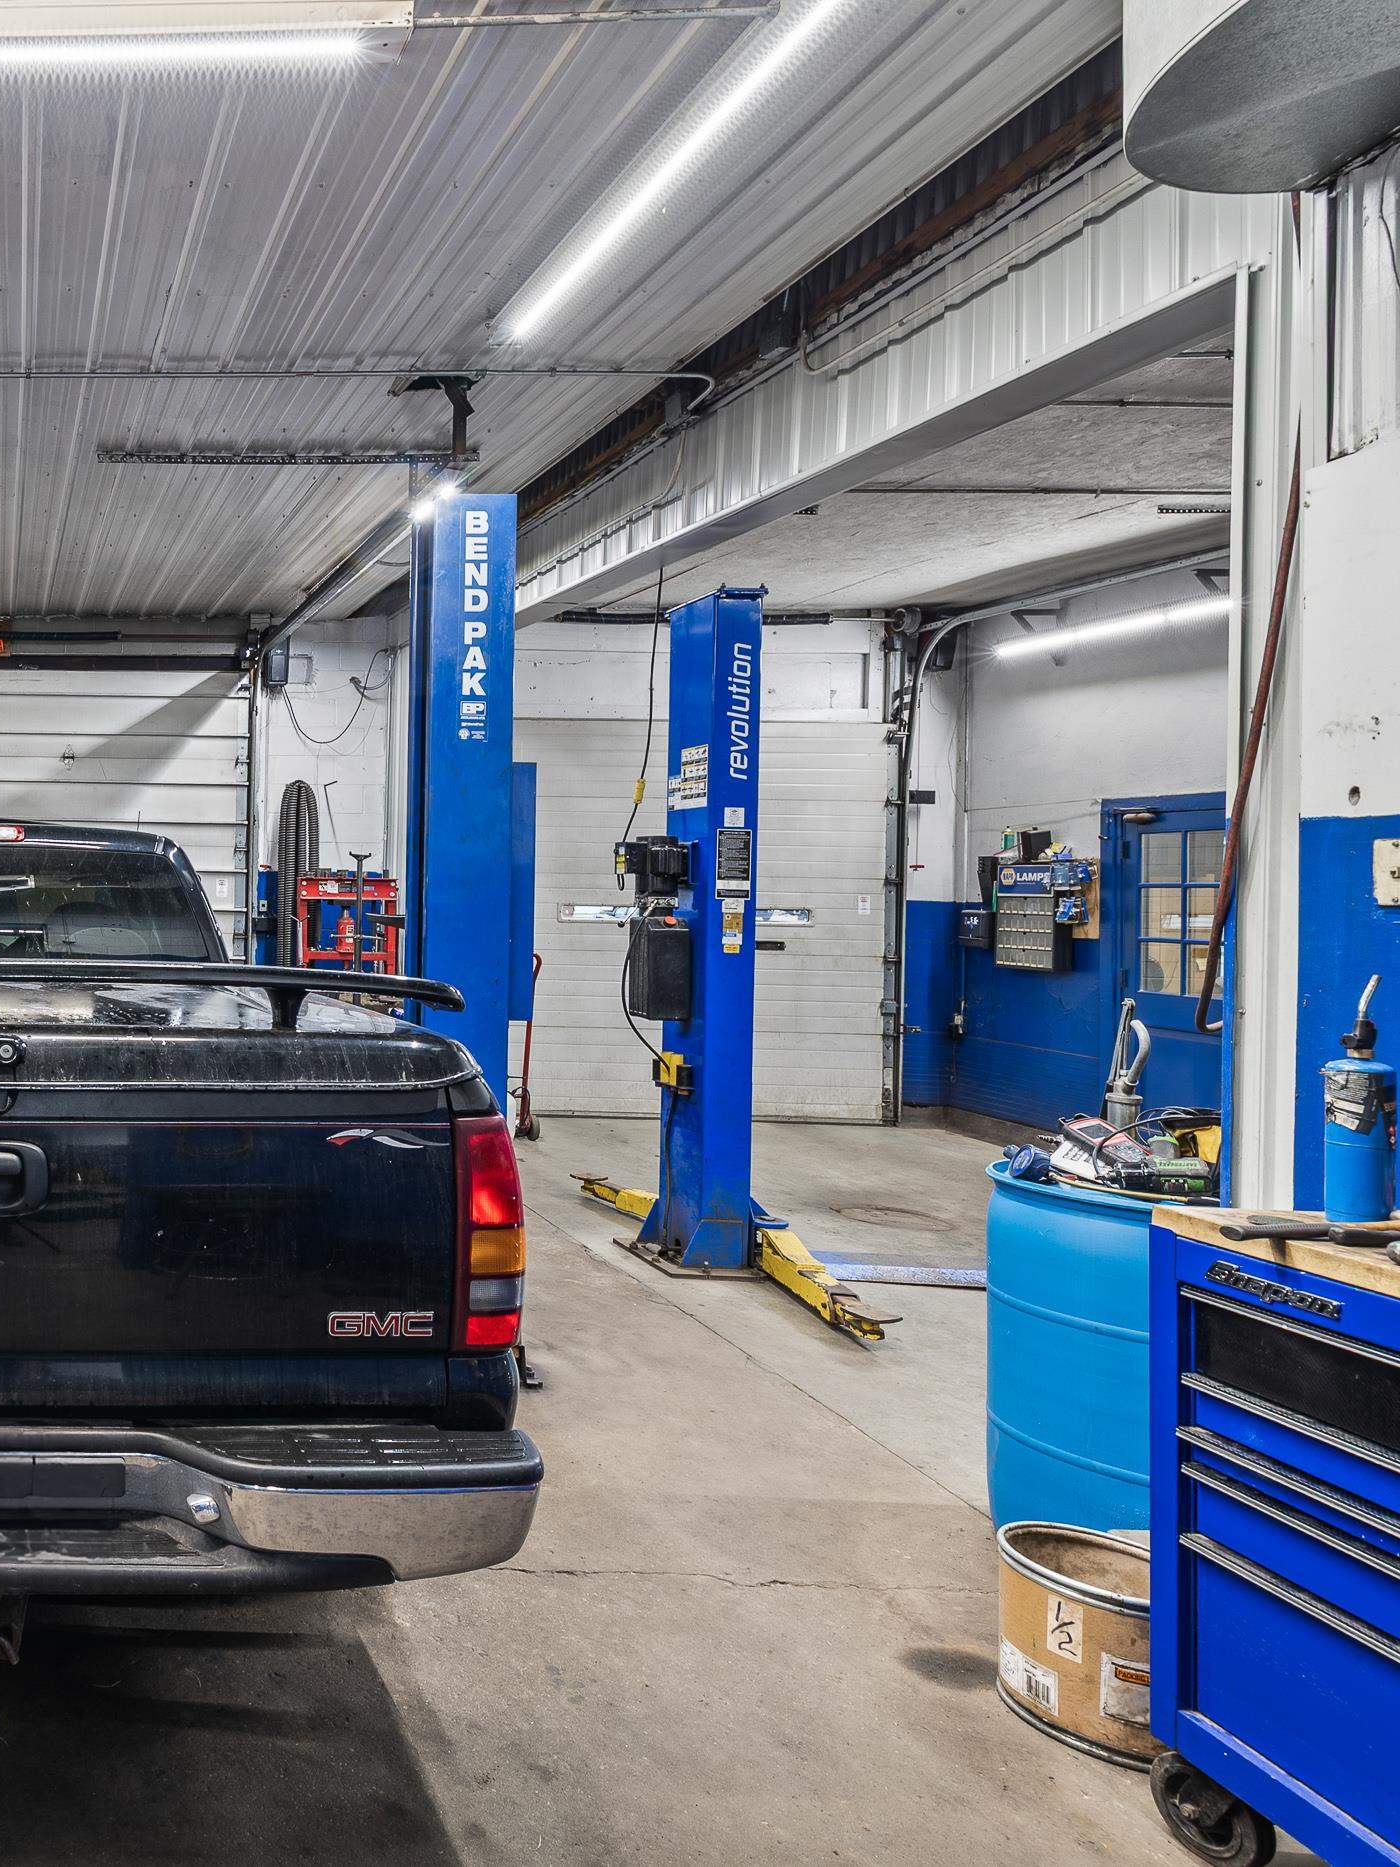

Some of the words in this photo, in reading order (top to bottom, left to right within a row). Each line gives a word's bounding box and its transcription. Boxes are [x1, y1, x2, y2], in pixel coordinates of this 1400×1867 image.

[464, 510, 490, 613] BEND
[461, 621, 487, 696] PAK
[726, 642, 752, 780] revolution
[328, 1311, 434, 1337] GMC
